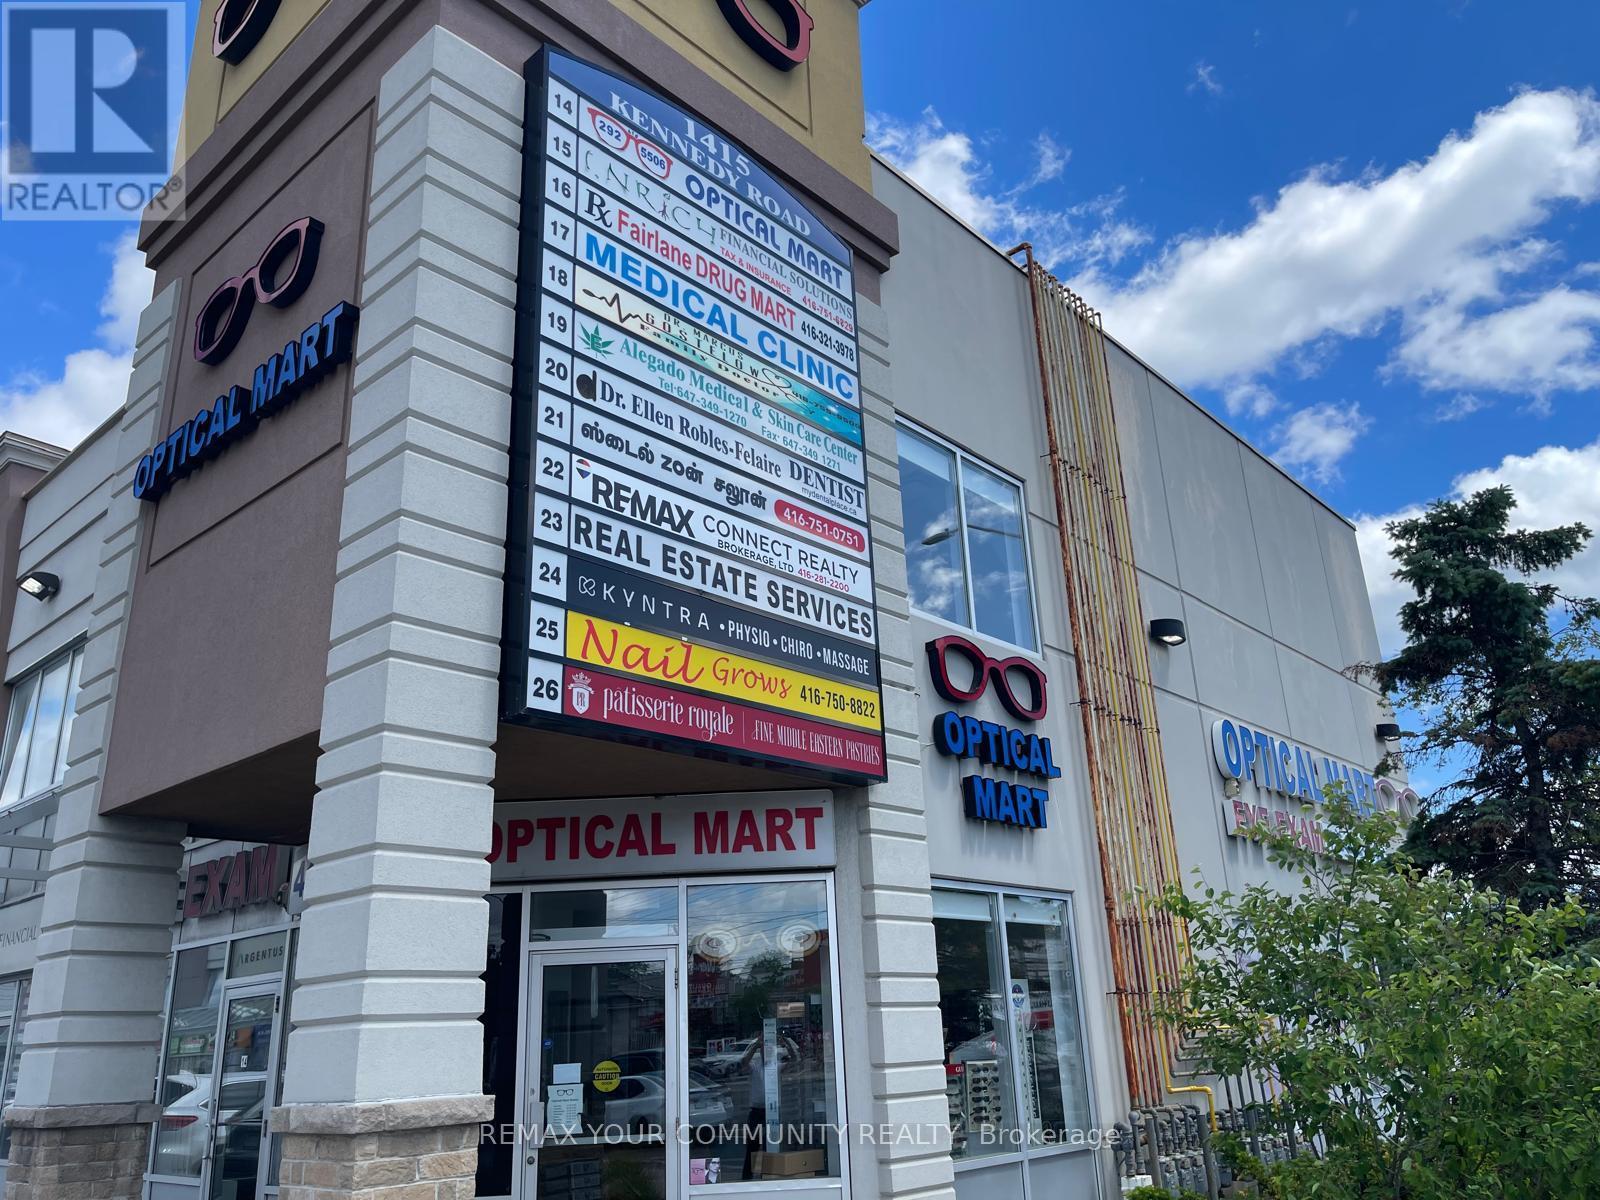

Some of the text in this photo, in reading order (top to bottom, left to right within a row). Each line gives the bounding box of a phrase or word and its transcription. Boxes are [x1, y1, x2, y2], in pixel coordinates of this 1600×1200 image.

[554, 93, 572, 115] 14
[553, 136, 571, 158] 15
[599, 120, 621, 142] 292
[684, 118, 750, 176] 1415
[609, 91, 811, 236] KENNEDY ROAD
[640, 147, 666, 170] 5506
[553, 177, 571, 198] 16
[551, 221, 569, 241] 17
[685, 174, 843, 289] OPTICAL MART
[549, 265, 568, 287] 18
[617, 209, 796, 331] Fairlane DRUG MART
[720, 247, 791, 296] TAX & INSURANCE
[720, 228, 853, 319] FINANCIAL SOLUTIONS
[548, 312, 567, 333] 19
[585, 232, 853, 400] MEDICAL CLINIC
[801, 321, 854, 362] 416-321-3978
[545, 358, 568, 381] 20
[133, 300, 352, 498] OPTICAL MART
[544, 406, 563, 429] 21
[620, 338, 858, 465] Alegado Medical & Skin Care Center
[600, 380, 864, 509] Dr. Ellen Robles-Felaire DENTIST
[822, 456, 841, 472] 1271
[542, 457, 564, 480] 22
[541, 509, 563, 531] 23
[783, 508, 859, 548] 416-751-0751
[703, 515, 792, 561] CONNECT
[799, 549, 859, 585] REALTY
[778, 561, 794, 573] LTD
[539, 562, 561, 585] 24
[575, 514, 873, 638] REAL ESTATE SERVICES
[798, 568, 850, 592] 416-281-2200
[536, 617, 559, 640] 25
[603, 583, 870, 675] KYNTRA PHYSIO CHIRO MASSAGE
[533, 677, 559, 700] 26
[581, 619, 876, 719] Nail Grows 416-750-8822
[689, 704, 734, 741] royale
[752, 720, 774, 744] FINE
[777, 725, 807, 751] MIDDLE
[810, 732, 843, 758] EASTERN
[846, 739, 880, 766] PASTRIES
[938, 711, 1061, 779] OPTICAL
[1215, 719, 1377, 818] OPTICAL MART
[967, 775, 1049, 828] MART
[694, 807, 824, 855] MART
[183, 843, 278, 918] EXAM
